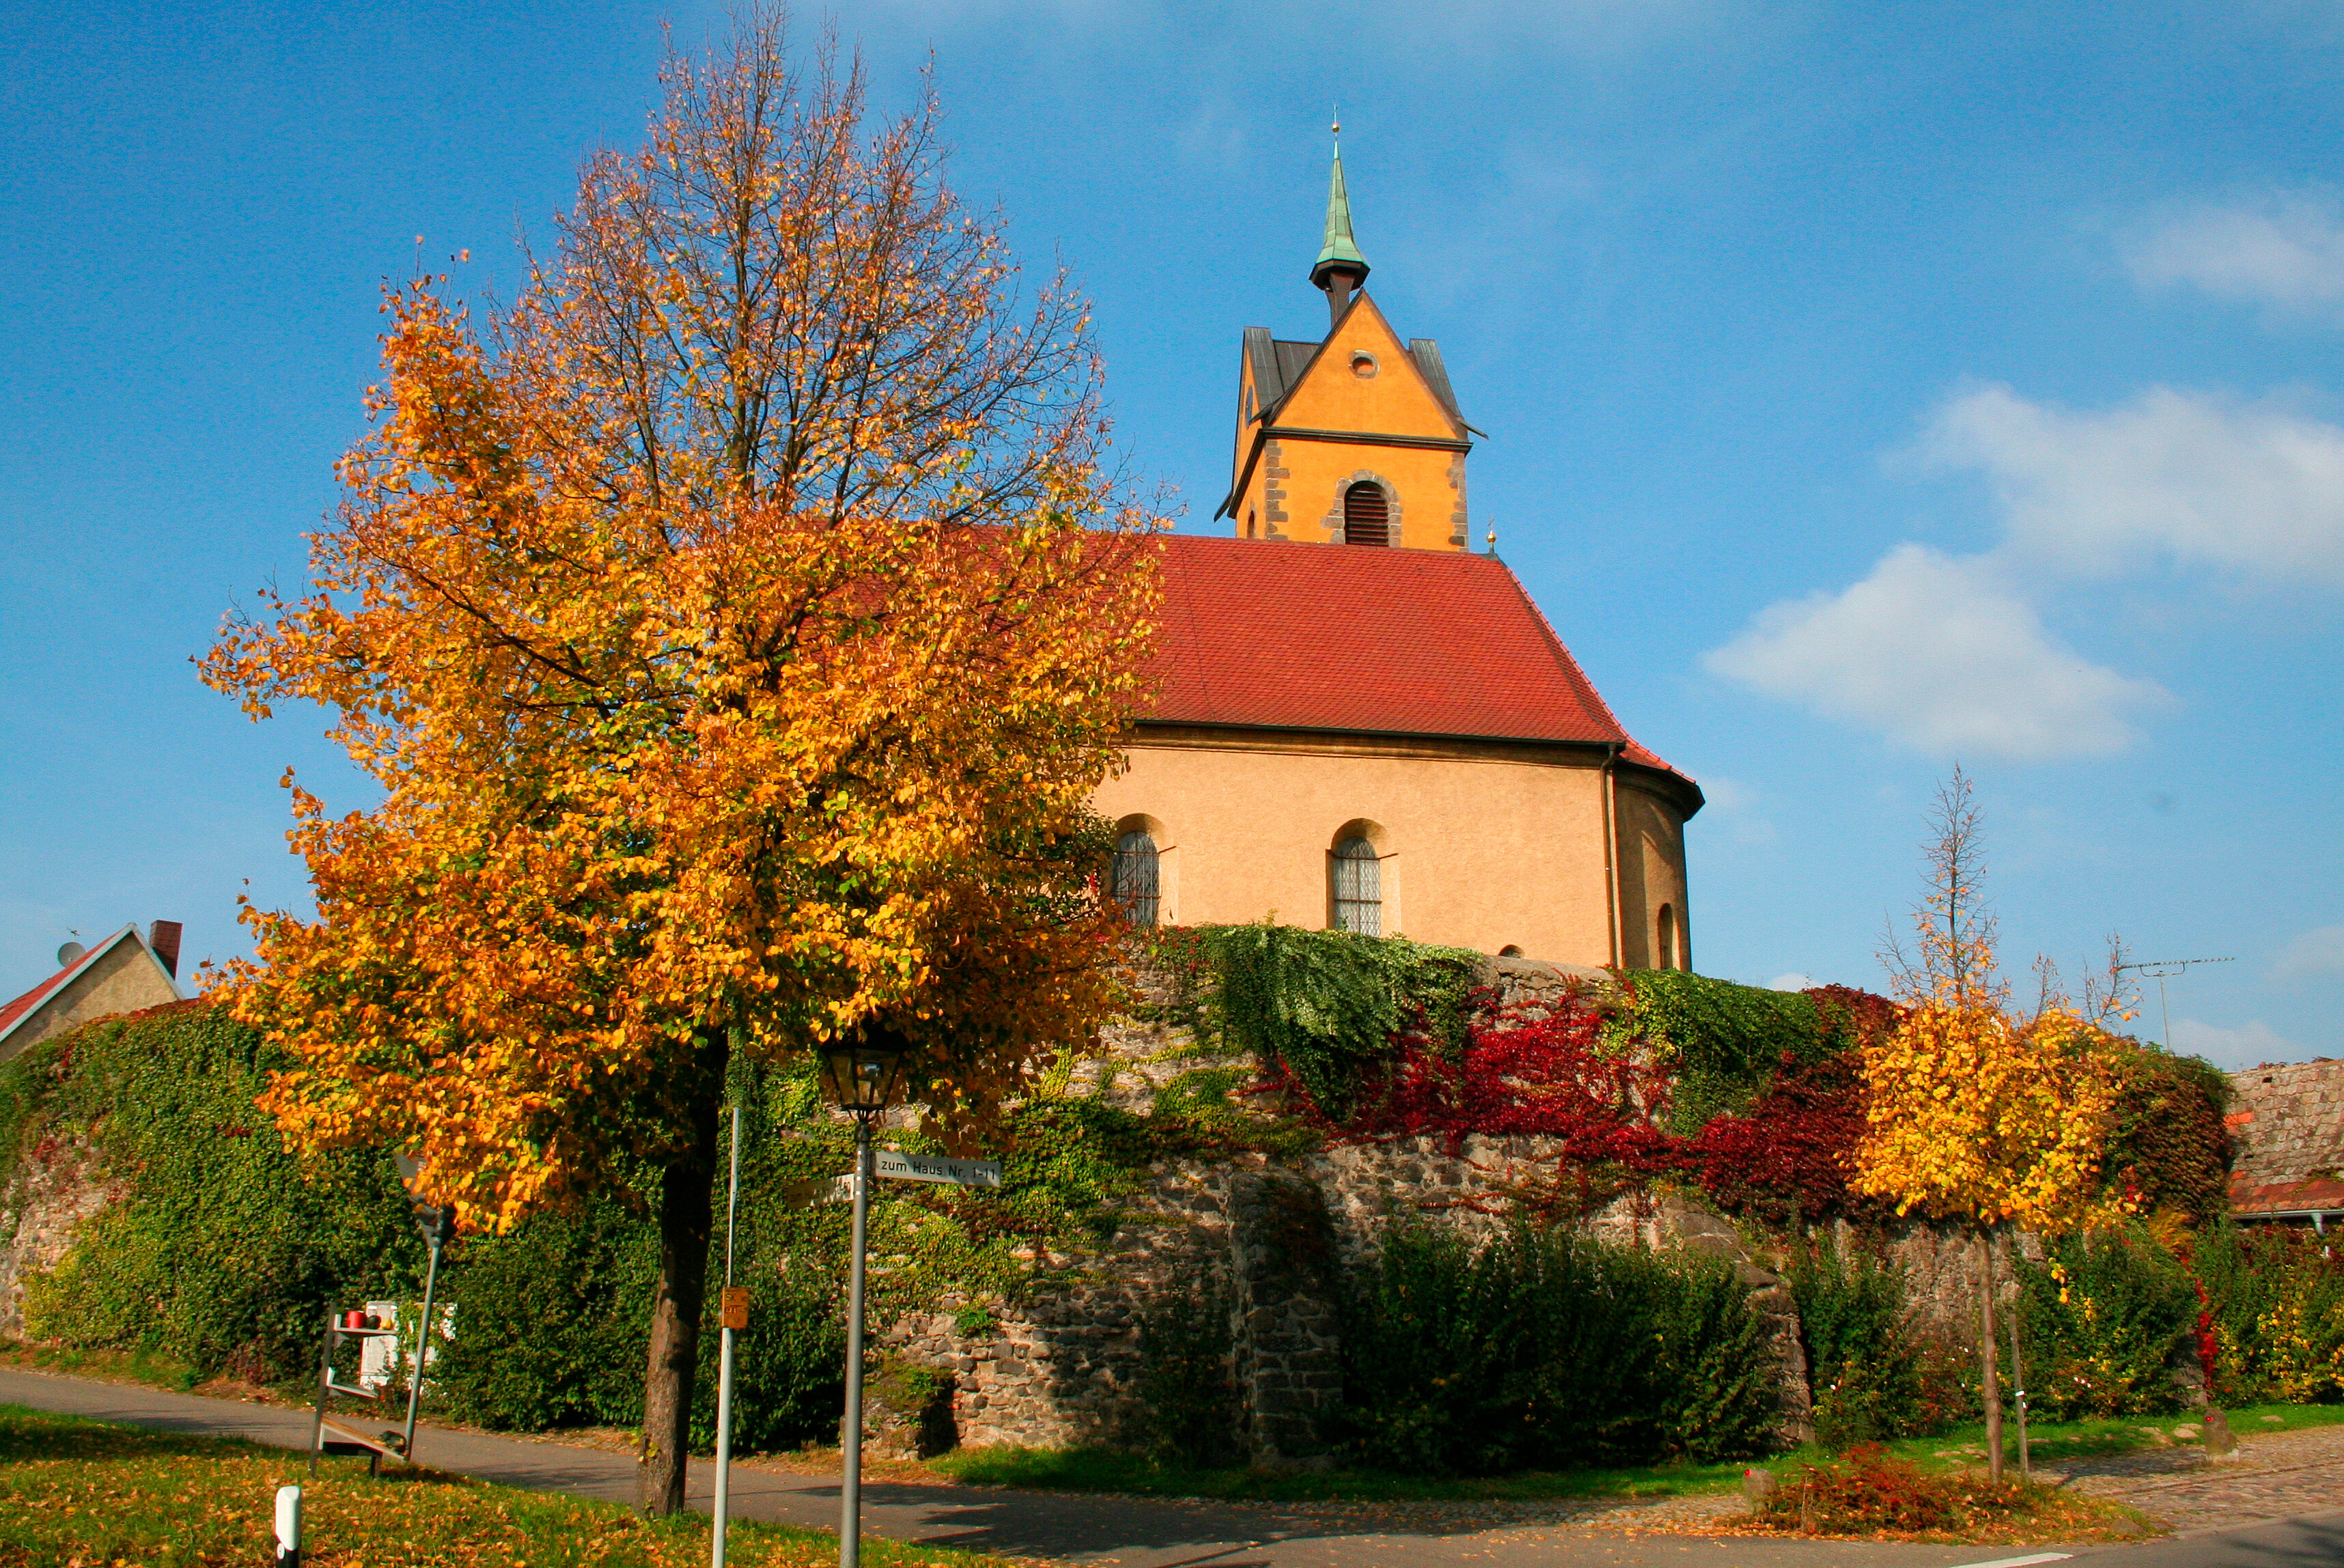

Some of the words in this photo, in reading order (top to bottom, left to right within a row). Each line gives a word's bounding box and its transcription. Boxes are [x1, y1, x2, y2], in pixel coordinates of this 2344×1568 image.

[881, 1161, 906, 1172] zum
[913, 1162, 943, 1175] Haus
[949, 1165, 966, 1177] Nr.
[973, 1166, 995, 1180] 1-11
